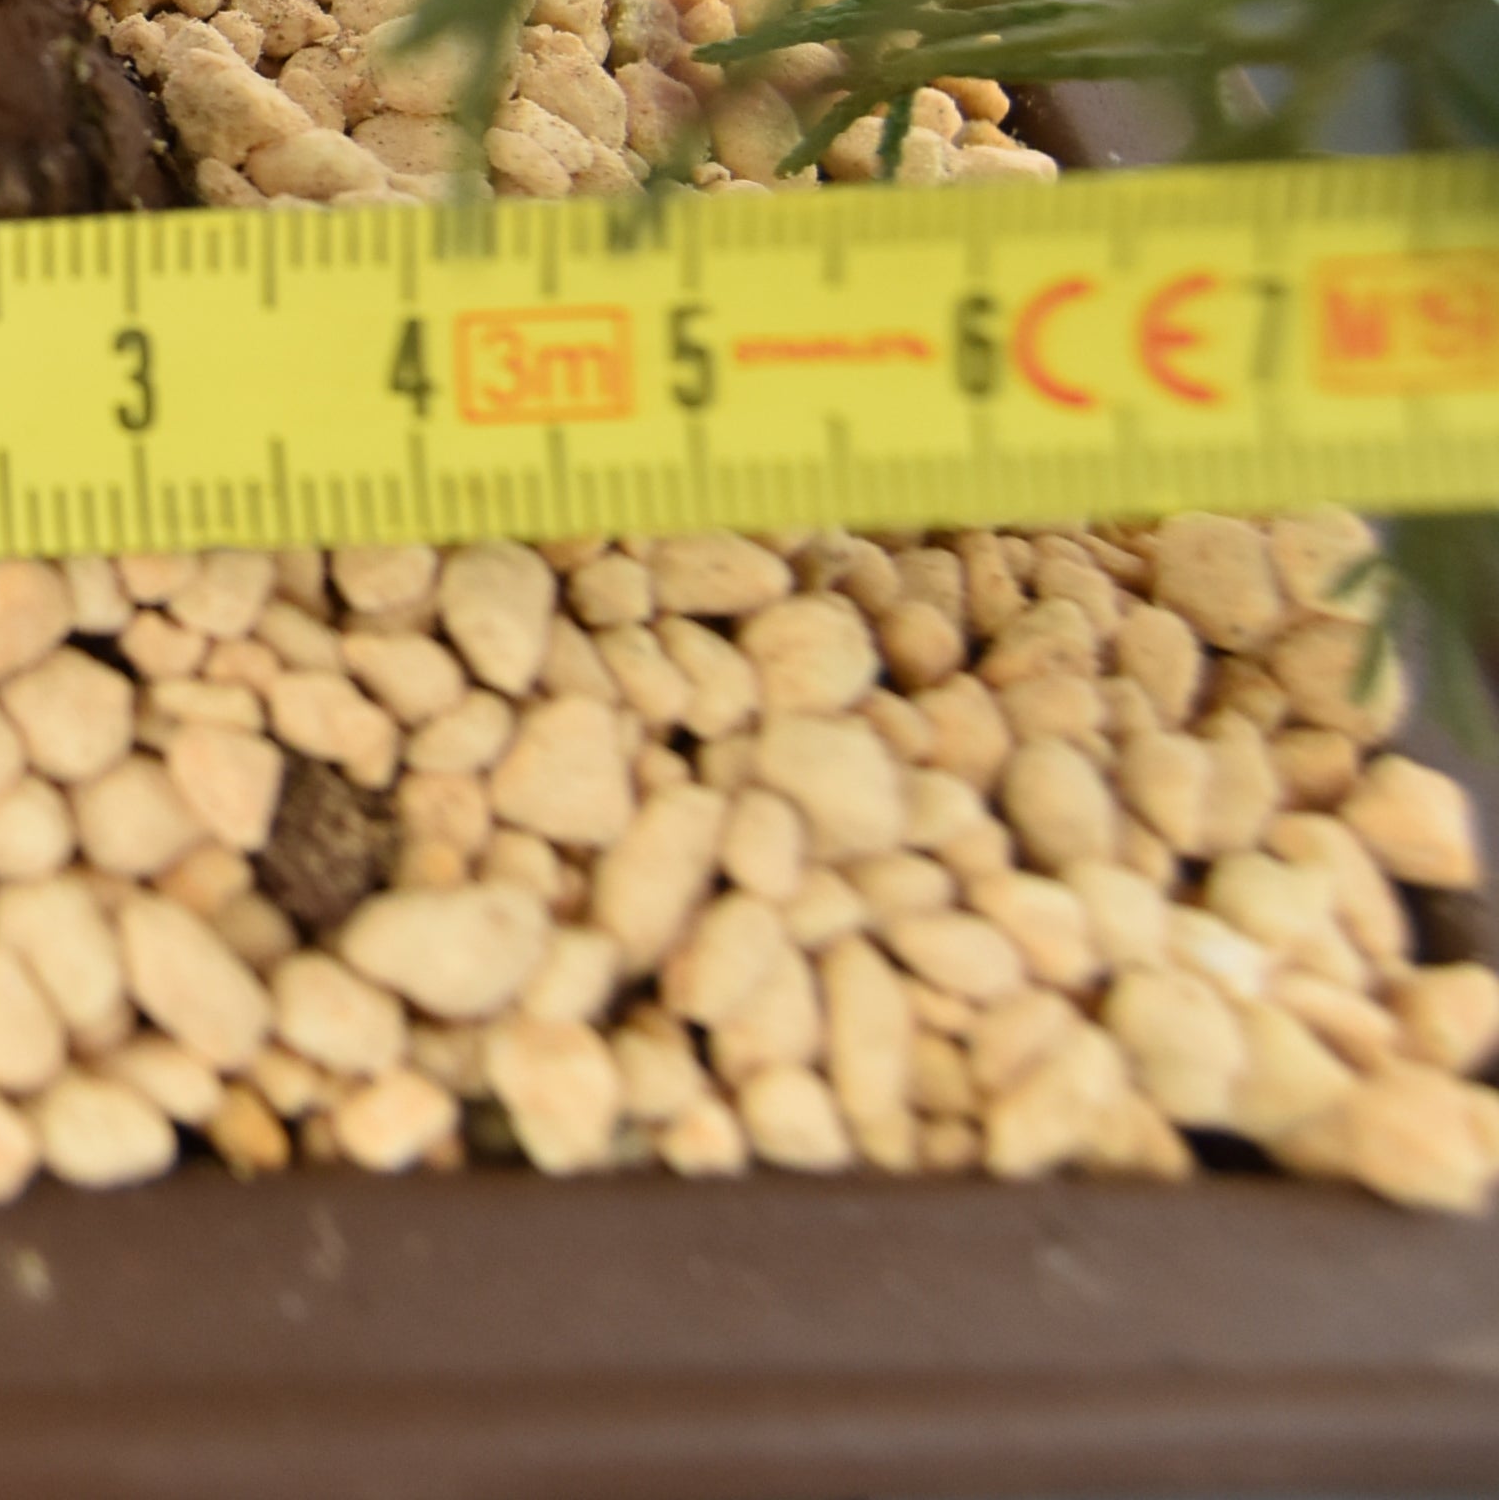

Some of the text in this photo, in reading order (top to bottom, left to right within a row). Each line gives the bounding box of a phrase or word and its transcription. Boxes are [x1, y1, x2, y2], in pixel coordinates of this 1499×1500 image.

[112, 327, 156, 433] 3
[387, 315, 436, 419] 4
[480, 324, 625, 410] 3m
[670, 303, 718, 410] 5
[952, 293, 1001, 400] 6
[1009, 270, 1223, 408] CE
[1237, 274, 1289, 382] 7
